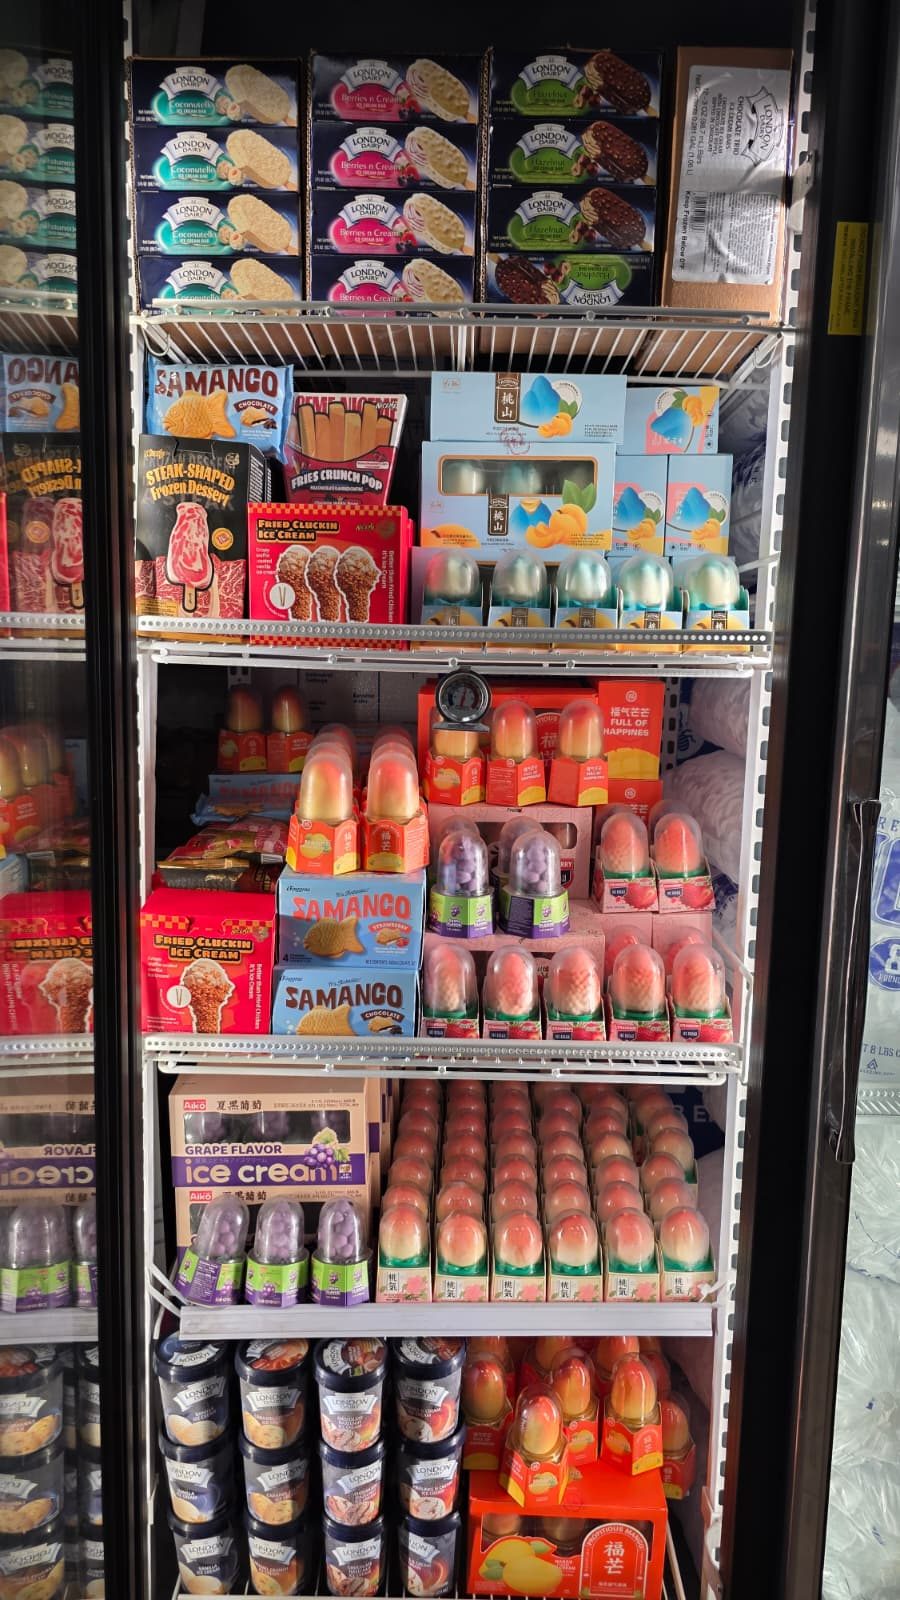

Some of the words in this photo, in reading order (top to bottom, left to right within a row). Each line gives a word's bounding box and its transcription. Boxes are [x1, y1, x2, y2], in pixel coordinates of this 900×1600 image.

[353, 69, 391, 80] LONDON
[532, 64, 571, 75] LONDON
[171, 74, 210, 86] LONDON
[735, 96, 745, 137] CHOCOLATE
[760, 104, 773, 151] LONDON
[353, 136, 390, 147] LONDON
[530, 132, 569, 143] LONDON
[173, 140, 211, 151] LONDON
[733, 139, 741, 156] TRIO
[341, 162, 367, 170] Berries
[352, 203, 389, 214] LONDON
[528, 200, 566, 210] LONDON
[176, 206, 213, 216] LONDON
[682, 210, 690, 234] Frozen
[340, 229, 365, 237] Berries
[680, 236, 688, 257] Below
[179, 270, 215, 280] LONDON
[351, 269, 388, 279] LONDON
[574, 296, 611, 306] LONDON
[238, 400, 274, 413] CHOCOLATE
[501, 392, 515, 418] 桃山
[146, 464, 235, 491] STEAK-SHAPED
[291, 470, 320, 490] FRIES
[321, 469, 361, 484] CRUNCH
[361, 473, 383, 491] POP
[150, 481, 186, 500] Frozen
[188, 480, 229, 508] Dessert
[258, 520, 291, 529] FRIED
[292, 520, 338, 530] CLUCKIN
[493, 510, 504, 531] 桃山
[258, 531, 276, 539] ICE
[277, 531, 315, 540] CREAM
[610, 719, 633, 727] FULL
[156, 935, 194, 946] FRIED
[197, 937, 252, 949] CLUCKIN
[170, 948, 191, 957] ICE
[194, 949, 239, 960] CREAM
[365, 1010, 401, 1020] CHOCOLATE
[184, 1102, 206, 1110] Aiko
[217, 1100, 262, 1111] 夏黑葡萄
[185, 1146, 228, 1155] GRAPE
[231, 1145, 282, 1155] FLAVOR
[185, 1158, 231, 1184] ice
[238, 1163, 337, 1184] cream
[185, 1382, 220, 1399] LONDON
[256, 1392, 292, 1401] LONDON
[416, 1466, 451, 1474] LONDON
[587, 1526, 624, 1547] PROPITIOUS
[188, 1542, 225, 1553] LONDON
[342, 1544, 377, 1556] LONDON
[604, 1541, 625, 1575] 福芒
